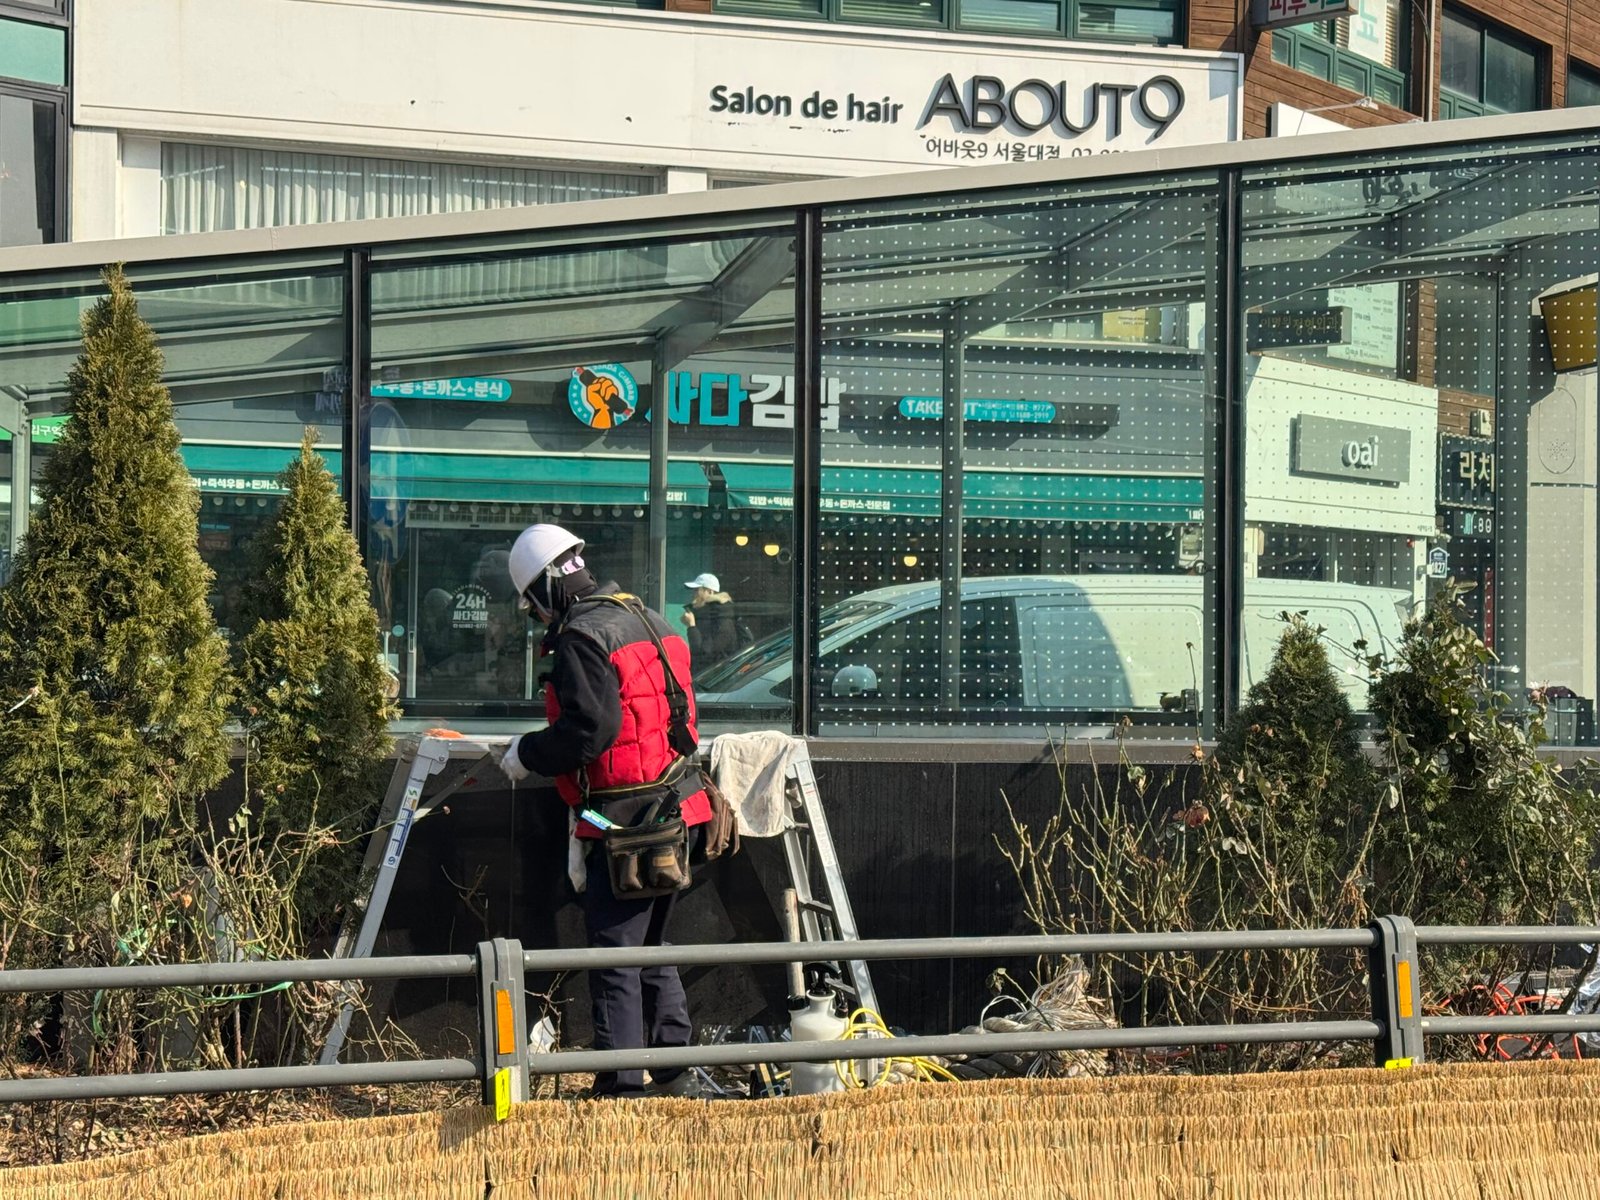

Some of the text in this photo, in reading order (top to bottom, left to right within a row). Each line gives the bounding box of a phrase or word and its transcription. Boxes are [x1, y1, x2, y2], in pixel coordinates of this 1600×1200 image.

[709, 84, 904, 124] Salon de hair
[917, 73, 1186, 144] ABOUT9
[925, 138, 989, 158] 어바웃9
[474, 381, 503, 398] 분식
[455, 593, 487, 609] 24H
